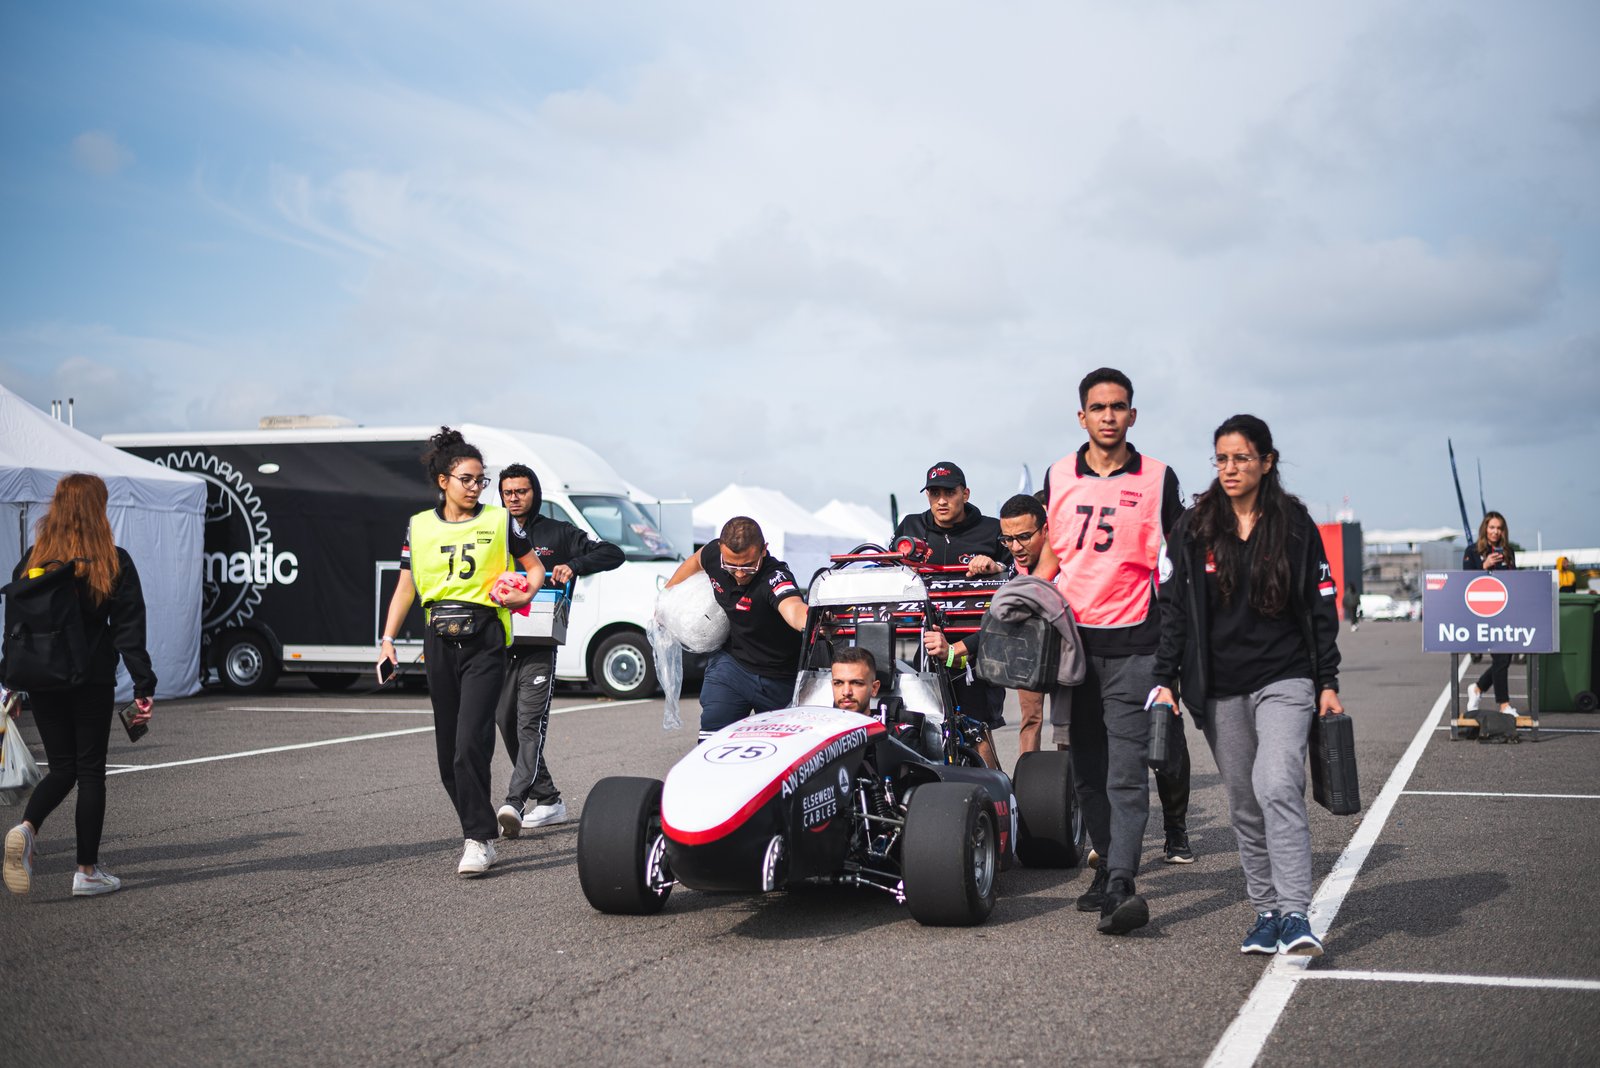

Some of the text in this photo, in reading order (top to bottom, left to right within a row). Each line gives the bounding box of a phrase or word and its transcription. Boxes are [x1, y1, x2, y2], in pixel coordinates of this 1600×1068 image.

[1075, 505, 1116, 553] 75
[440, 543, 476, 581] 75
[1438, 623, 1536, 647] No Entry
[717, 746, 767, 759] 75
[799, 751, 825, 783] SHAMS
[825, 727, 868, 763] UNIVERSITY
[803, 785, 835, 809] ELSEWEDY
[803, 803, 837, 827] CABLES
